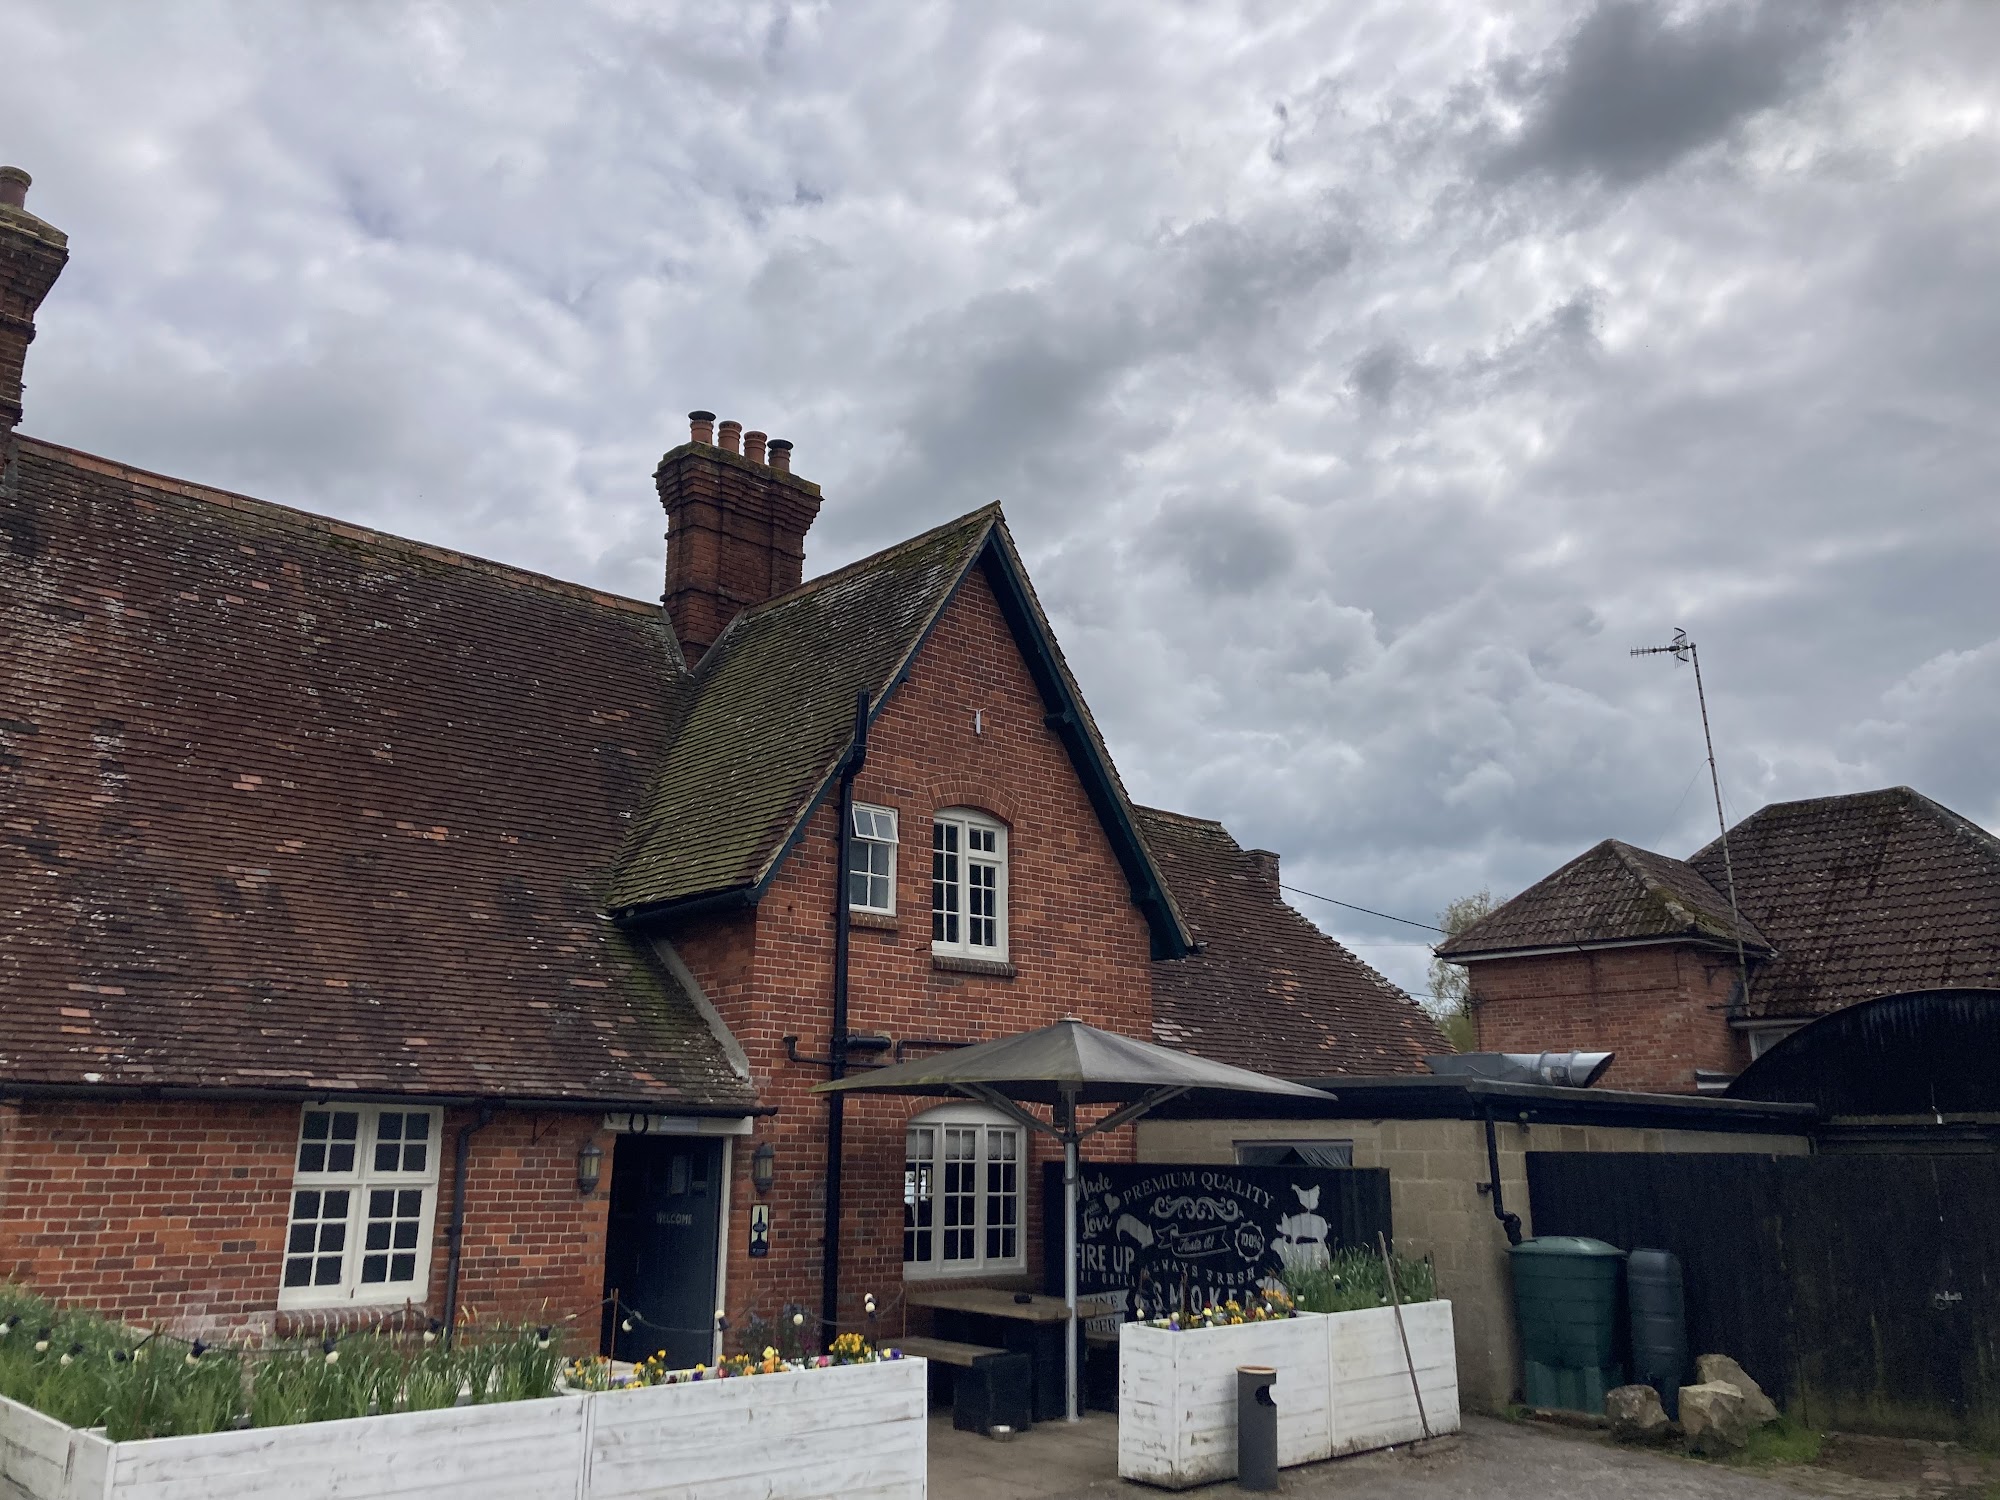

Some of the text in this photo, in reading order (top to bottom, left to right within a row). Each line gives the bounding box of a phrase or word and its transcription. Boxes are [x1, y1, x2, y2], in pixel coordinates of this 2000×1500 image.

[1076, 1172, 1112, 1201] Made
[1123, 1171, 1274, 1209] PREMIUM QUALITY
[656, 1211, 692, 1225] WELCOME
[1082, 1208, 1112, 1240] Love
[1241, 1232, 1262, 1251] 100%
[1076, 1243, 1135, 1275] FIRE UP
[1144, 1258, 1255, 1286] ALWAYS FRESH
[1102, 1272, 1136, 1288] GRILL
